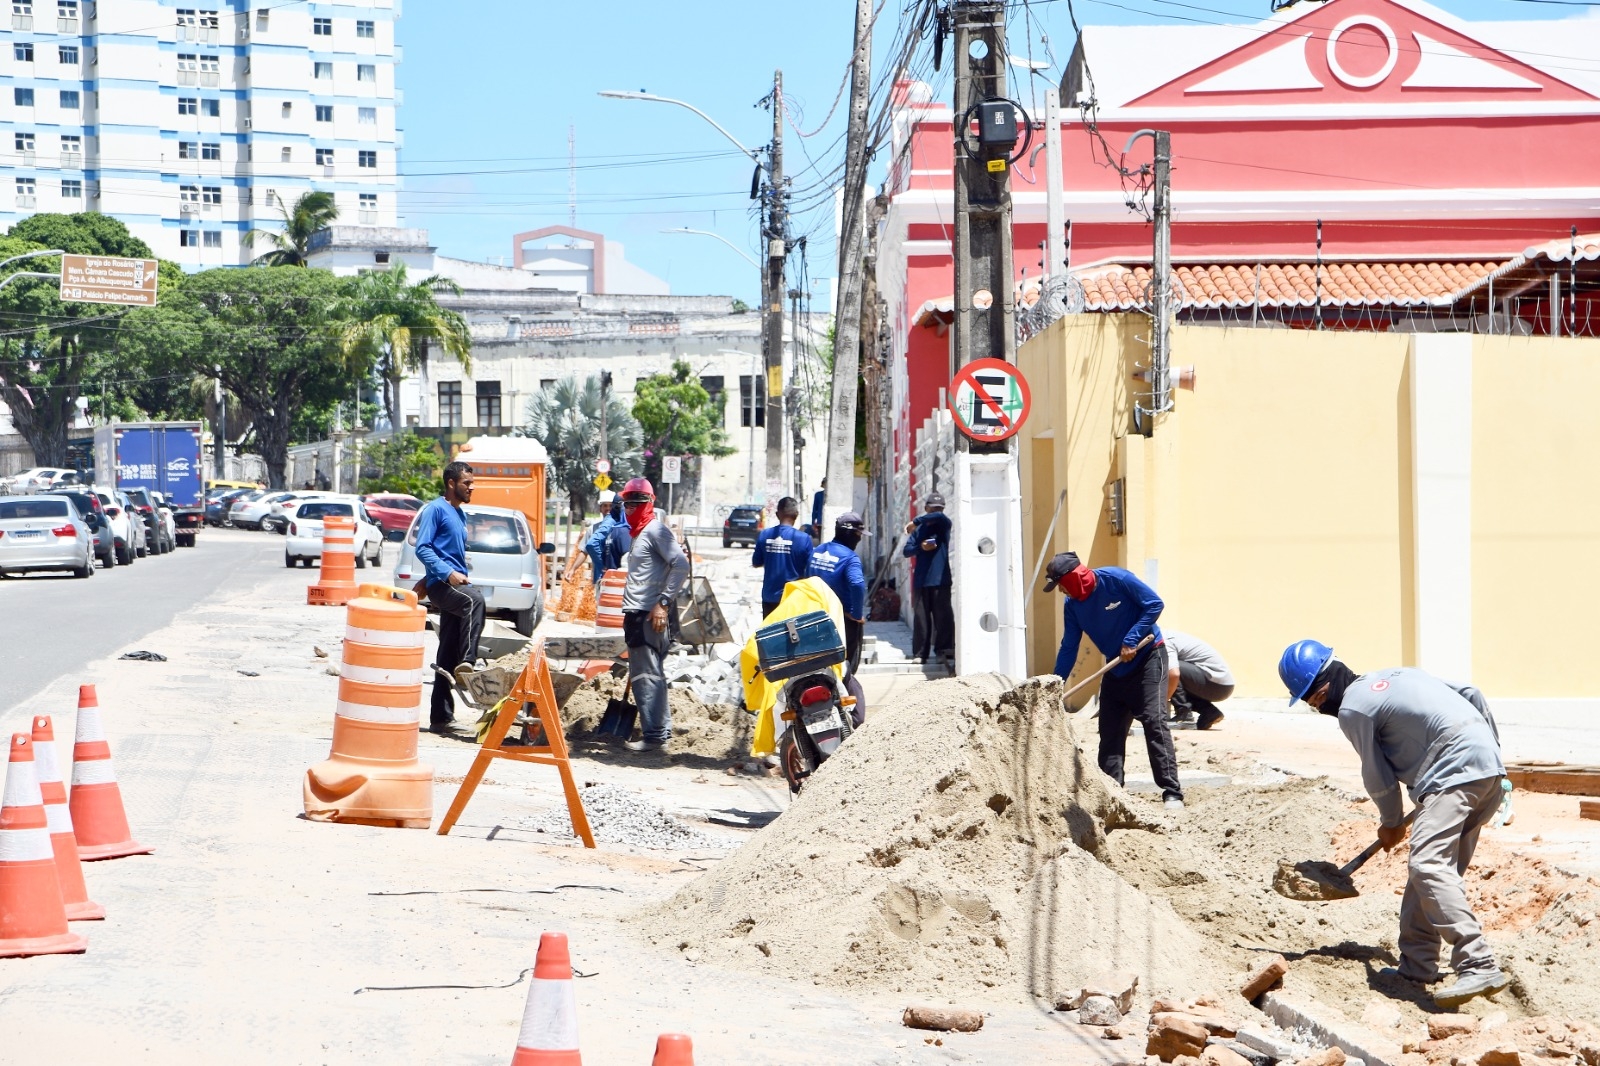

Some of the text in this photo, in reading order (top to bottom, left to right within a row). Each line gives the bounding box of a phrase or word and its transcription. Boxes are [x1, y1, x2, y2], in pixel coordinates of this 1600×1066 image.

[112, 260, 134, 268] Rosário
[85, 268, 107, 276] Câmara
[108, 269, 133, 278] Cascudo
[96, 277, 133, 286] Albuquerque
[82, 290, 103, 299] Palácio
[973, 376, 1006, 428] E
[669, 460, 675, 469] E
[310, 588, 325, 597] STTU
